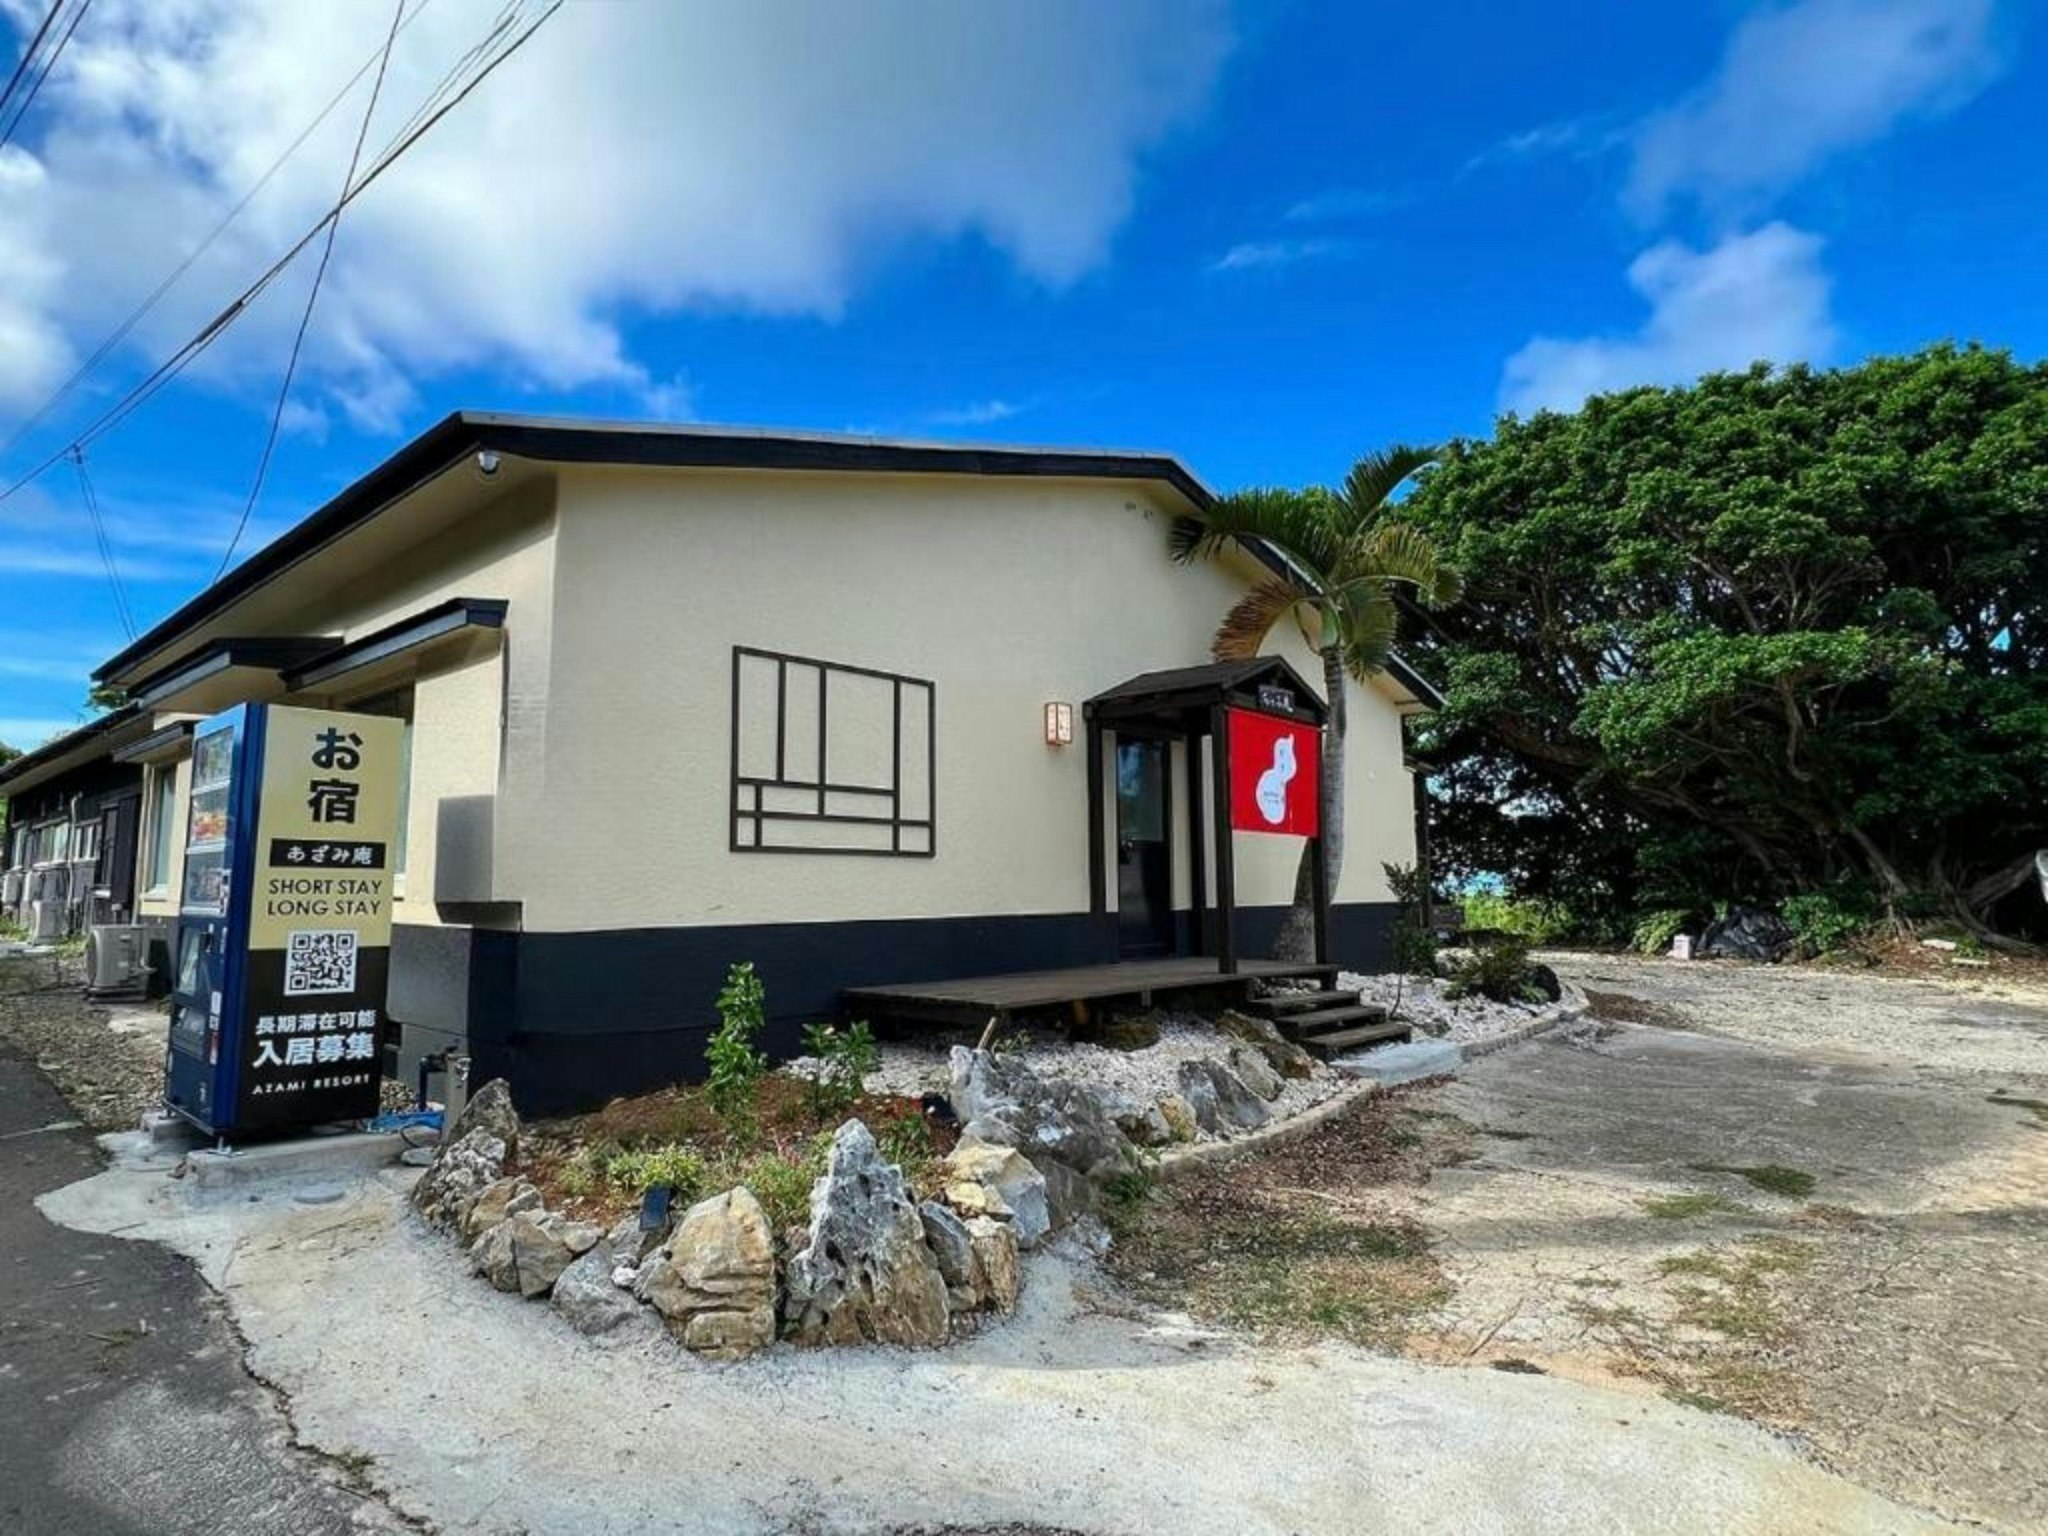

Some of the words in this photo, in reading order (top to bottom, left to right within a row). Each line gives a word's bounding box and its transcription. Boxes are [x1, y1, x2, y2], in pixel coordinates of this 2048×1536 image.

[308, 727, 363, 824] お宿
[287, 844, 373, 865] あざみ庵
[269, 879, 333, 895] SHORT
[337, 879, 382, 895] STAY
[267, 901, 328, 916] LONG
[335, 901, 381, 916] STAY
[256, 1009, 377, 1035] 長期滞在可能
[252, 1032, 374, 1068] 入居募集
[252, 1080, 306, 1095] AZAMI
[313, 1073, 370, 1089] RESORT
